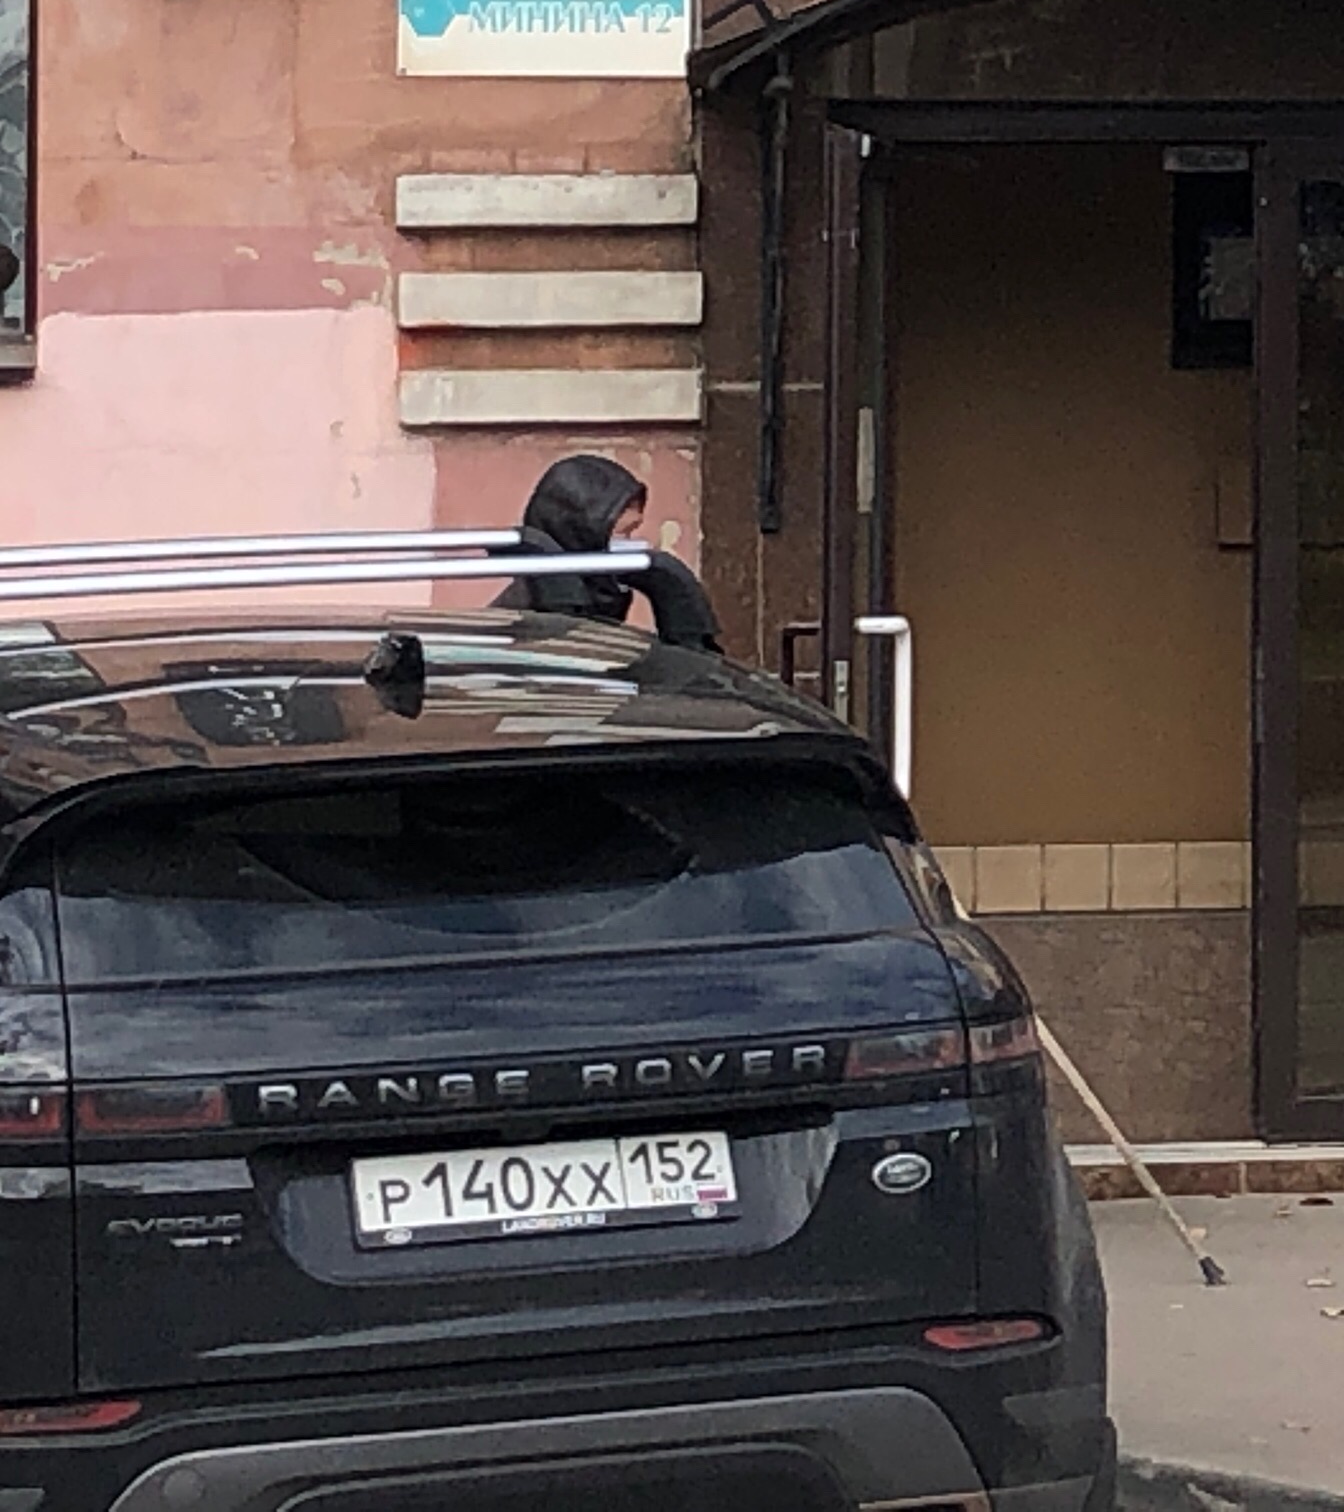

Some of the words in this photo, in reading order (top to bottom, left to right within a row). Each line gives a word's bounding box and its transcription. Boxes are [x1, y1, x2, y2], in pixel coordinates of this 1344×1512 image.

[469, 0, 626, 34] МИНИНА
[635, 2, 675, 34] 12
[258, 1070, 529, 1113] RANGE
[582, 1045, 830, 1087] ROVER
[628, 1139, 716, 1184] 152
[651, 1187, 694, 1202] RUS
[107, 1214, 243, 1235] EVOQUE
